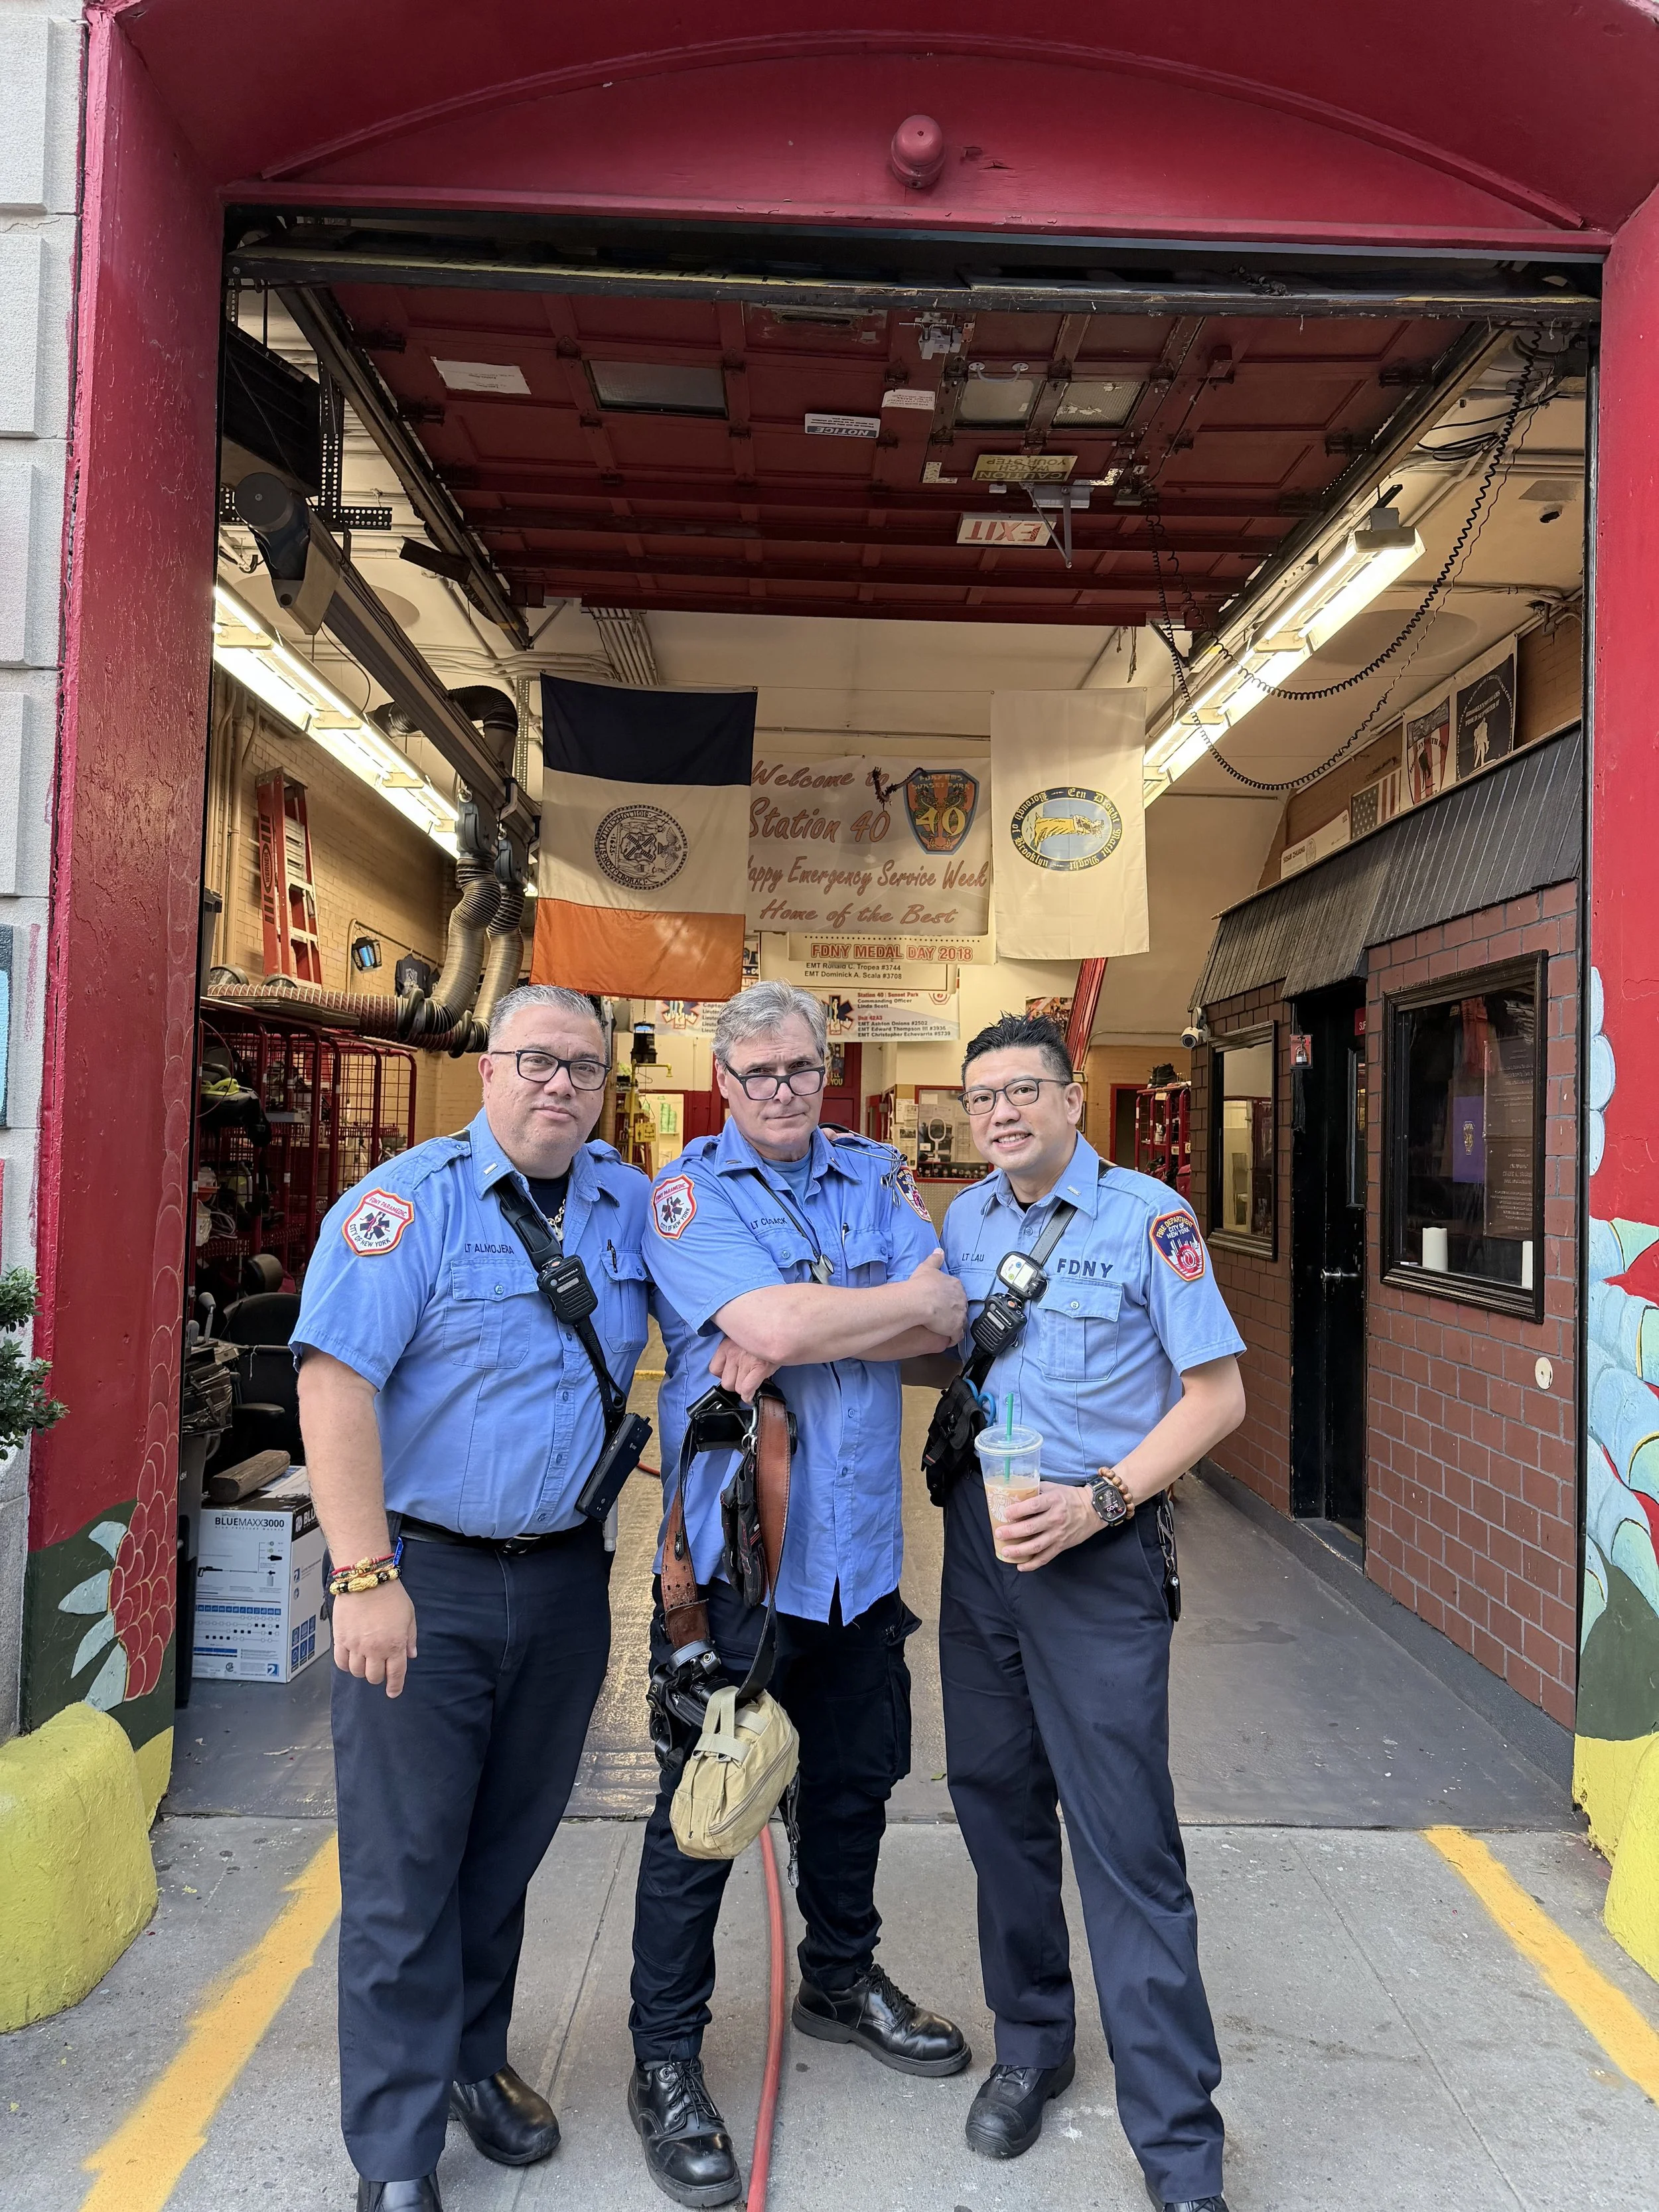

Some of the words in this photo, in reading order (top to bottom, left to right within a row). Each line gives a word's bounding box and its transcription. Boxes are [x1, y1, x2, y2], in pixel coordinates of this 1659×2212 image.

[815, 427, 869, 436] NOTICE
[966, 521, 1043, 542] EXIT
[751, 760, 855, 788] Welcome
[865, 769, 889, 788] to
[1015, 792, 1048, 820] Borough
[749, 797, 841, 843] Station
[850, 810, 891, 842] 40
[916, 807, 966, 836] 40
[1012, 824, 1021, 834] of
[1013, 835, 1048, 867] Brooklyn
[788, 856, 873, 897] Emergency
[877, 859, 936, 886] Service
[942, 861, 989, 889] Week
[760, 899, 819, 921] Home
[826, 903, 854, 929] of
[857, 905, 893, 922] the
[901, 904, 959, 924] Best
[811, 943, 851, 958] FDNY
[853, 944, 903, 959] MEDAL
[906, 945, 936, 960] DAY
[938, 946, 973, 961] 2018
[664, 1183, 685, 1195] PARAMEDIC
[380, 1202, 407, 1217] PARAMEDIC
[673, 1219, 682, 1229] NEW
[680, 1208, 690, 1221] YORK
[751, 1220, 758, 1230] LT
[760, 1217, 788, 1226] CUSACK
[1156, 1224, 1167, 1238] FIRE
[1164, 1216, 1194, 1228] DEPARTMENT
[1167, 1230, 1179, 1239] NEW
[1178, 1226, 1190, 1235] YORK
[1169, 1224, 1179, 1232] CITY
[375, 1237, 391, 1247] YORK
[465, 1243, 471, 1253] LT
[474, 1243, 514, 1254] ALMOJERA
[558, 1268, 578, 1282] MOTOROLA
[1056, 1258, 1114, 1278] FDNY
[215, 1517, 285, 1527] BLUEMAXX3000
[303, 1508, 316, 1525] BLU
